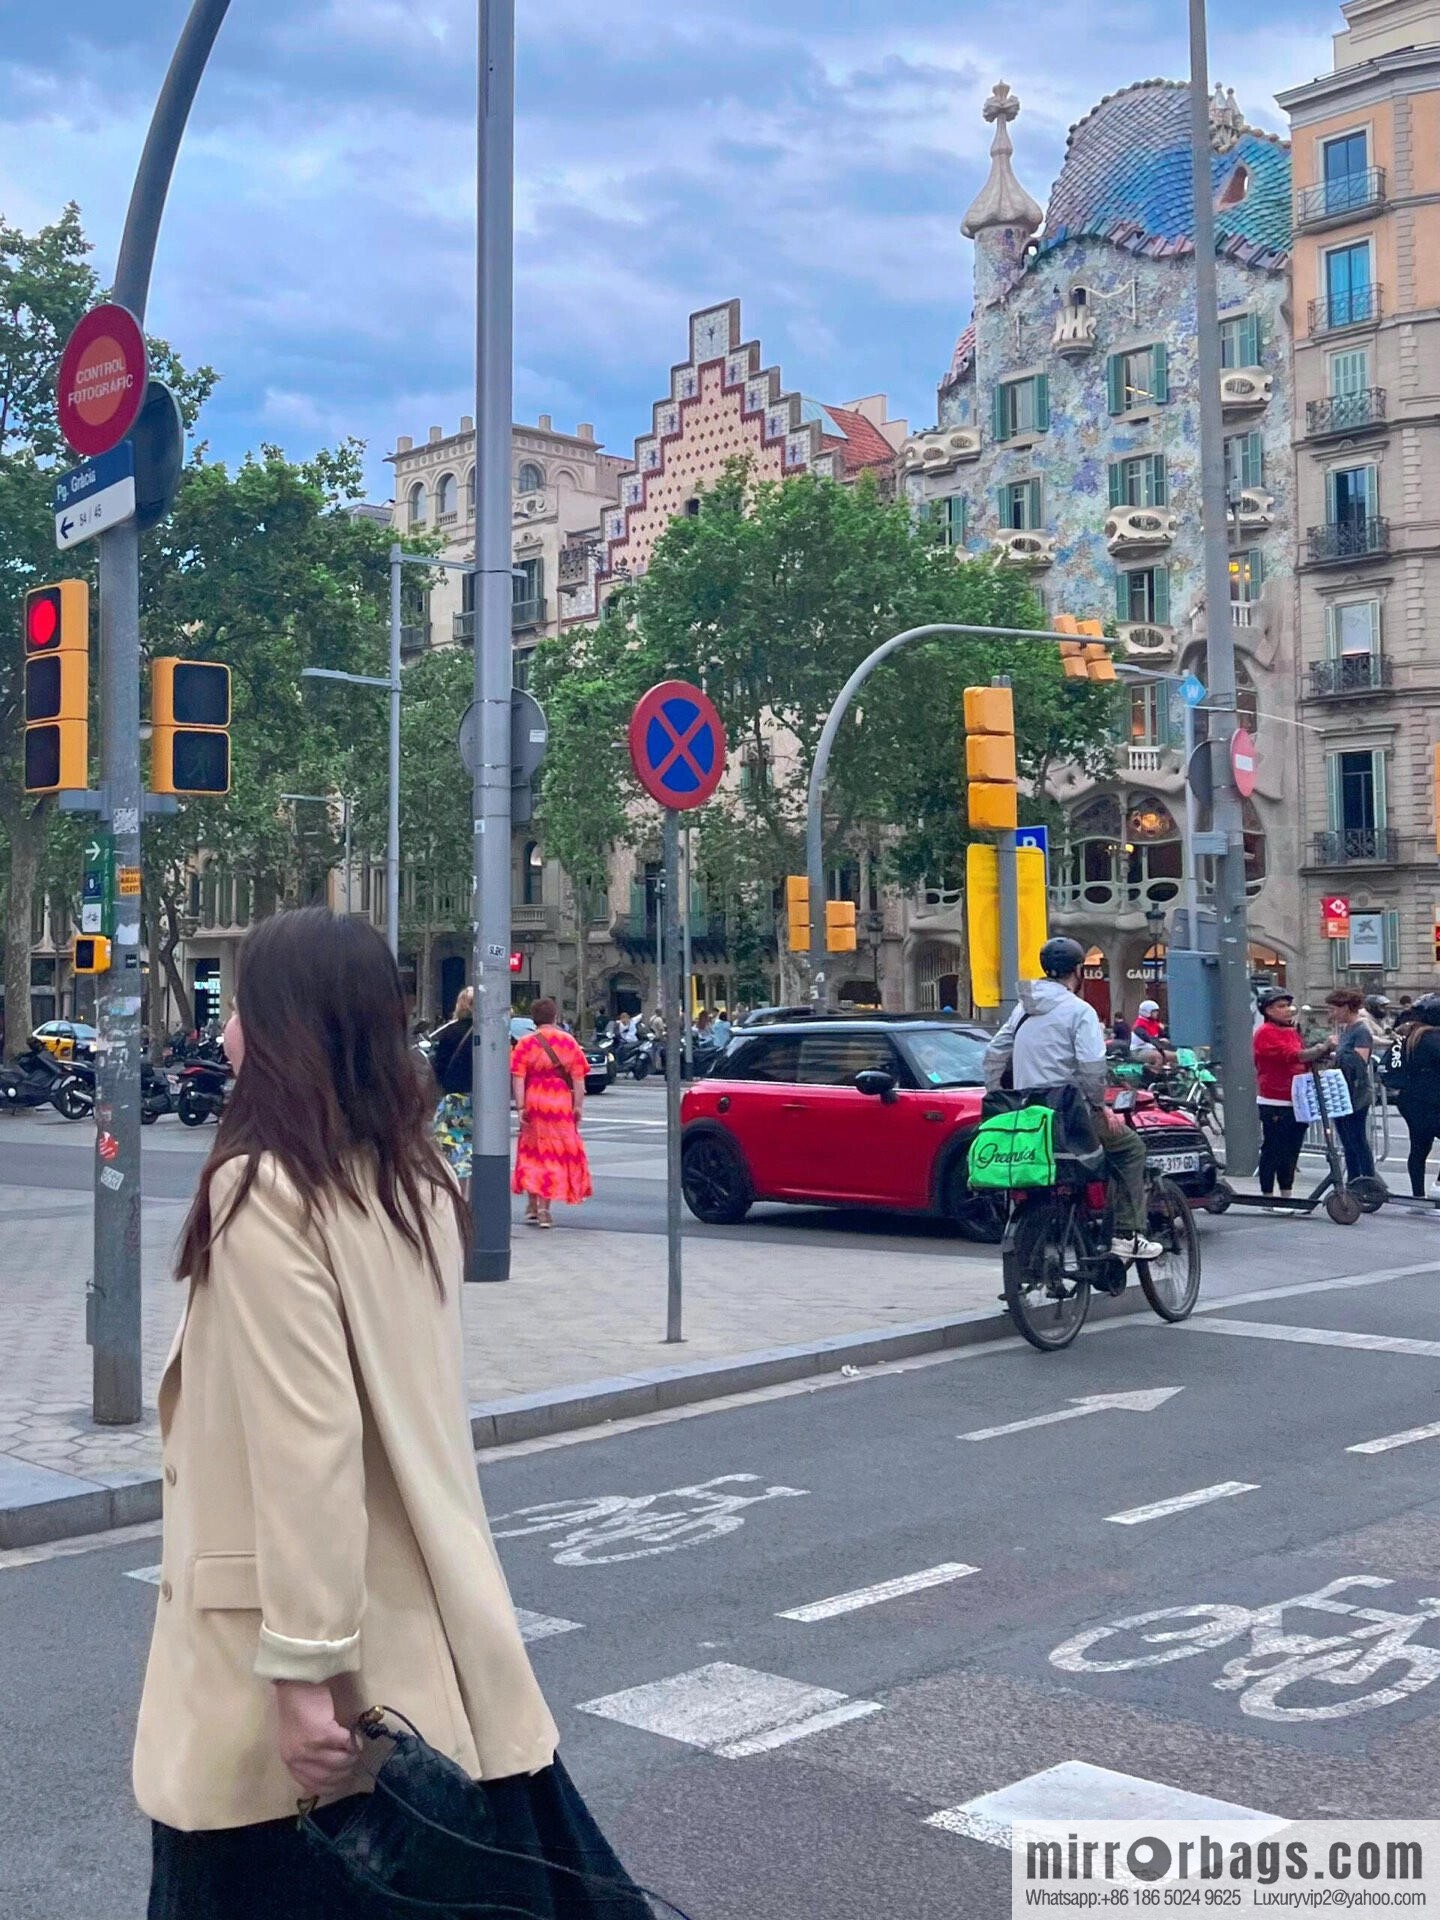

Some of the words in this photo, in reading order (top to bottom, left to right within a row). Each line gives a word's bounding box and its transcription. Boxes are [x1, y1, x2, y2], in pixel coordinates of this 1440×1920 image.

[76, 358, 126, 384] CONTROL
[56, 484, 70, 502] Pg.
[1083, 966, 1104, 979] LLÓ
